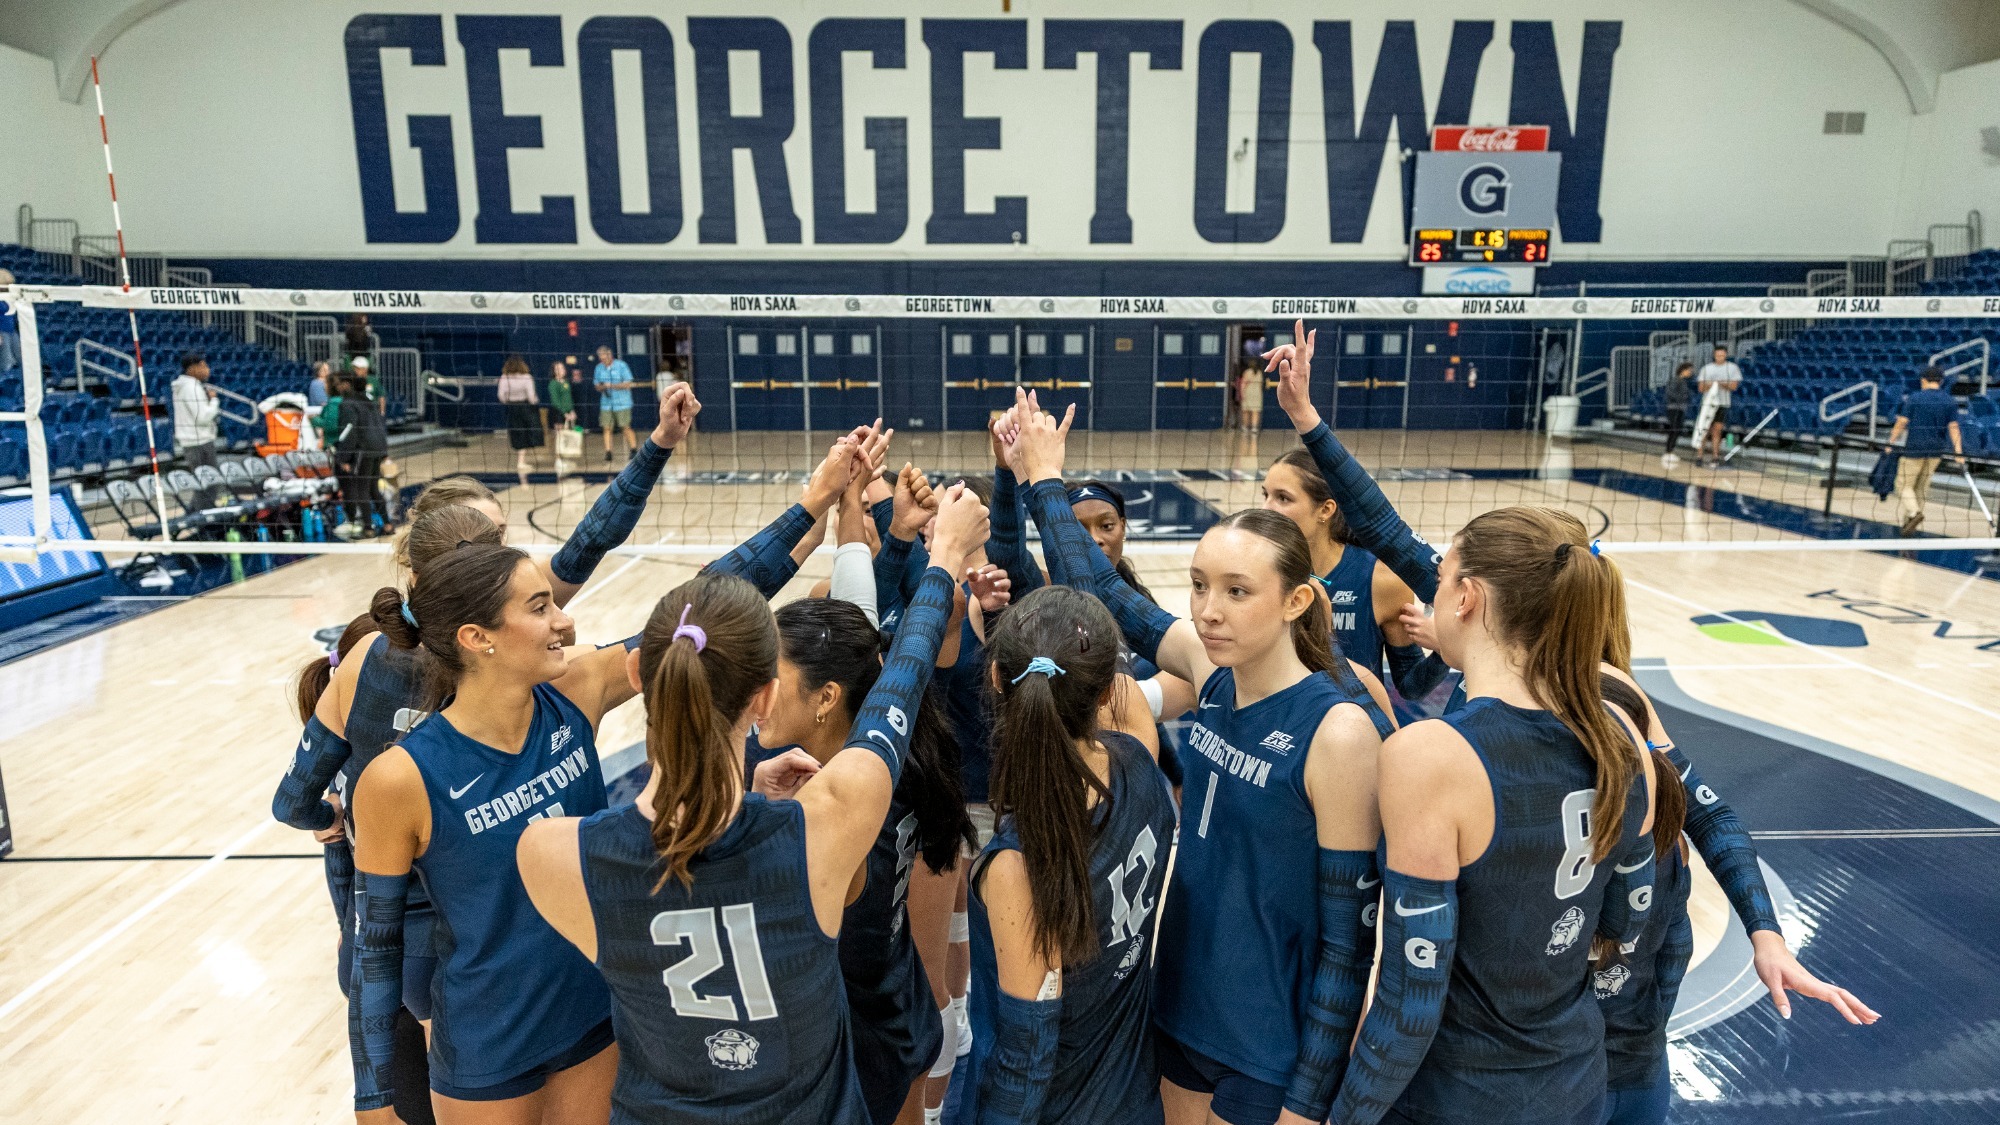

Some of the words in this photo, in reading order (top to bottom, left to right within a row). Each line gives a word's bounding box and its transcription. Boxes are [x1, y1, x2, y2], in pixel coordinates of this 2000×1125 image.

[344, 13, 1622, 243] GEORGETOWN
[1458, 162, 1511, 217] G
[1419, 243, 1442, 261] 25
[1524, 243, 1547, 261] 21
[151, 289, 241, 305] GEORGETOWN
[353, 292, 386, 307] HOYA
[389, 292, 422, 307] SAXA
[532, 294, 620, 309] GEORGETOWN
[731, 296, 761, 311] HOYA
[765, 296, 796, 311] SAXA
[906, 298, 992, 312] GEORGETOWN
[1100, 298, 1130, 313] HOYA
[1134, 298, 1166, 313] SAXA
[1272, 299, 1356, 314] GEORGETOWN
[1462, 299, 1492, 314] HOYA
[1495, 299, 1525, 314] SAXA
[1631, 299, 1714, 313] GEORGETOWN
[1817, 299, 1847, 313] HOYA
[1850, 299, 1881, 313] SAXA
[1263, 736, 1296, 751] EAST
[1269, 730, 1294, 743] BIG
[1188, 721, 1273, 788] GEORGETOWN
[464, 746, 589, 835] GEORGETOWN
[1198, 770, 1219, 839] 1
[1554, 788, 1598, 900] 8
[1107, 824, 1158, 948] 12
[1404, 937, 1439, 969] G
[650, 902, 778, 1021] 21
